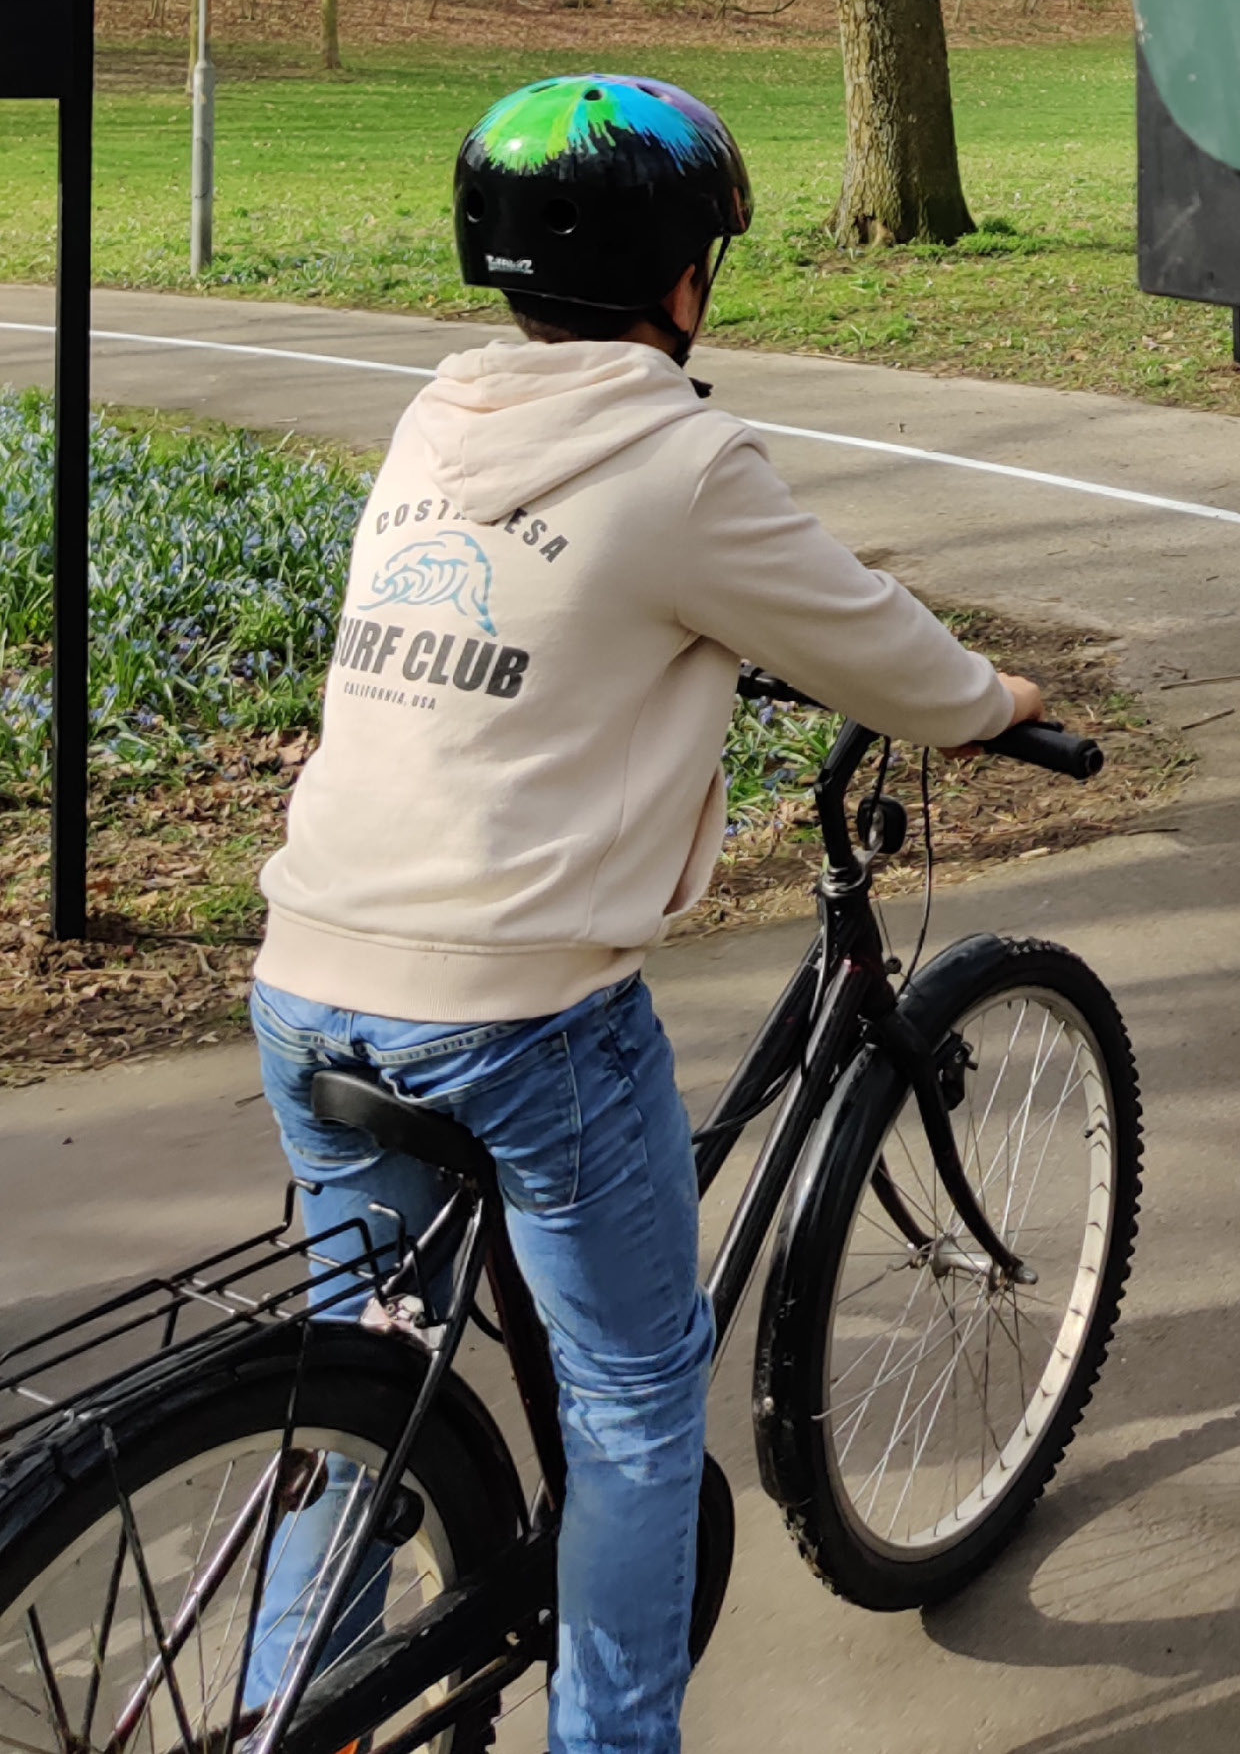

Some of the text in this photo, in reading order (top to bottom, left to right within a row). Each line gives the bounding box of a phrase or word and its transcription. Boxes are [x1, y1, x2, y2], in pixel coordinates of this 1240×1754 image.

[503, 507, 569, 563] ESA
[402, 630, 530, 699] CLUB
[411, 694, 436, 710] USA
